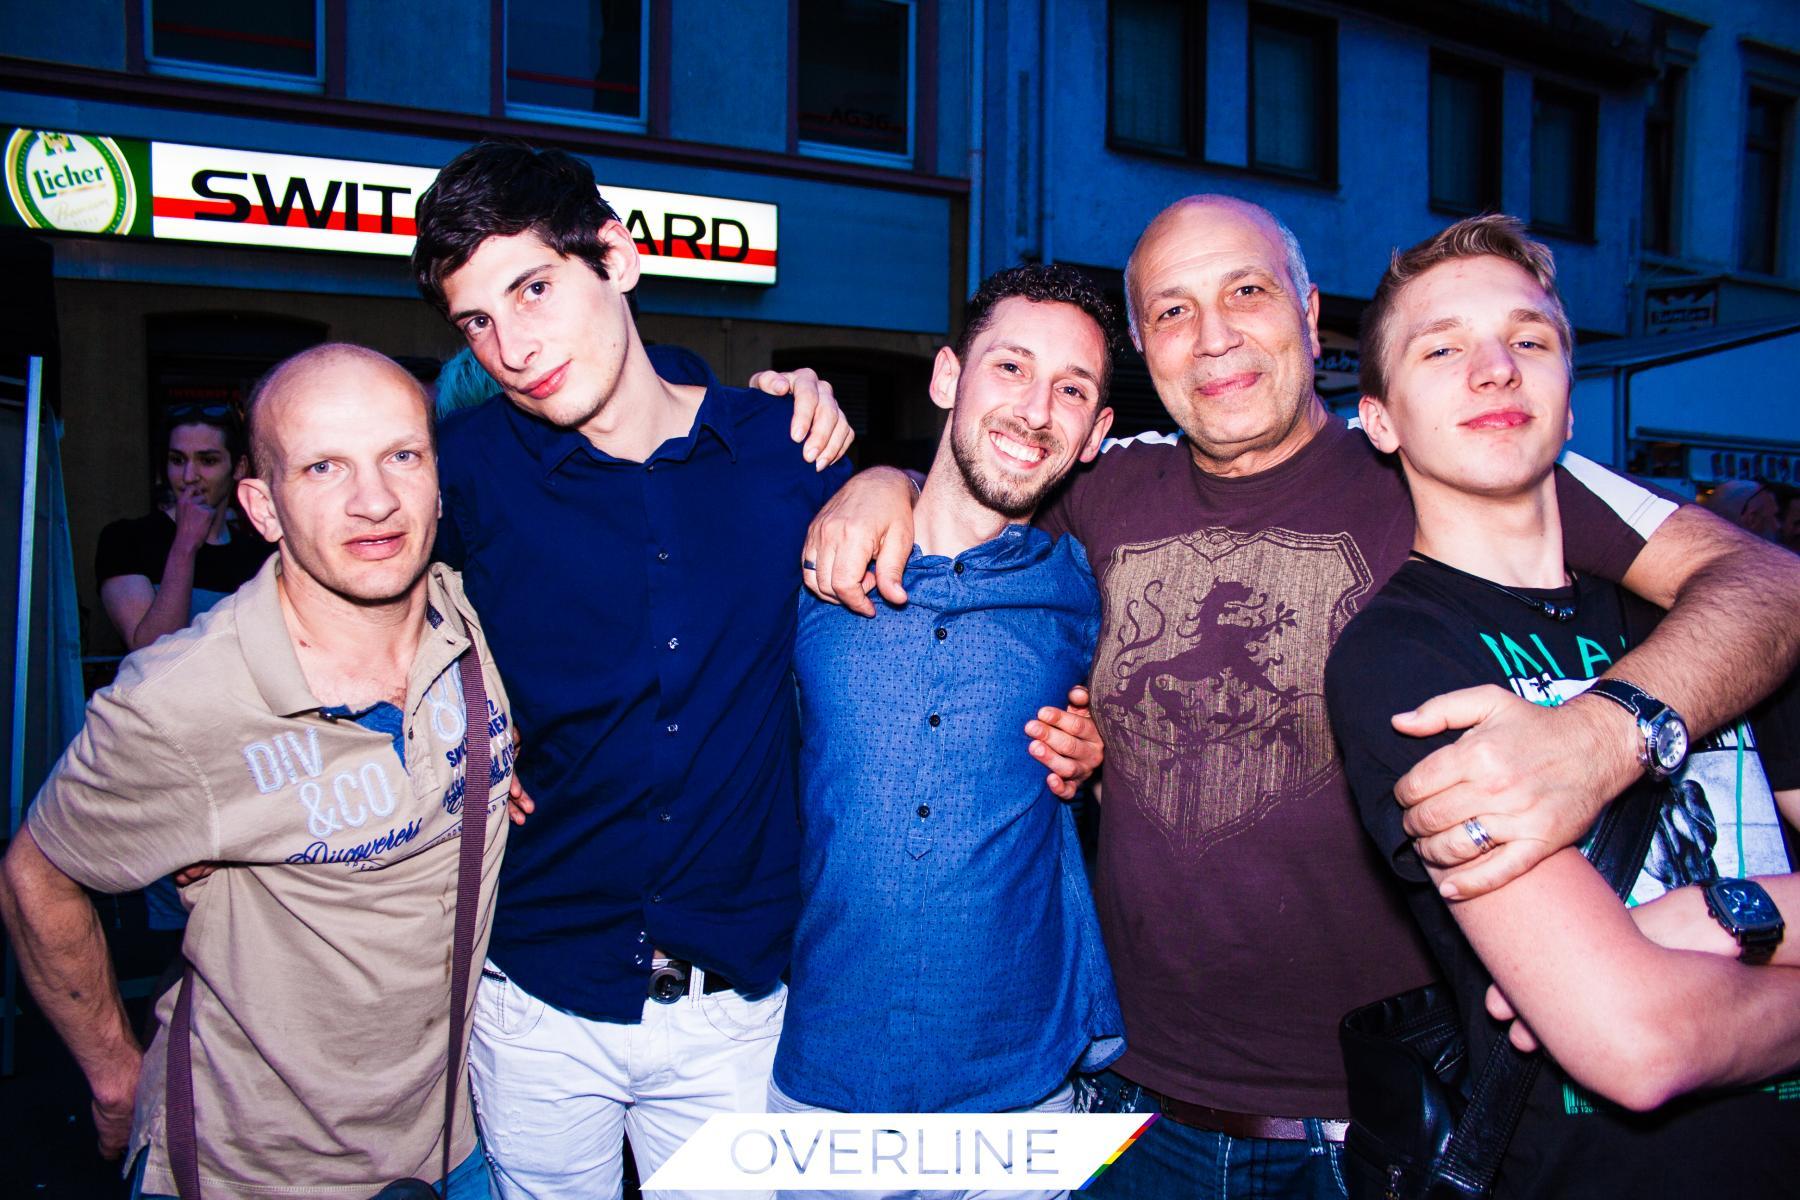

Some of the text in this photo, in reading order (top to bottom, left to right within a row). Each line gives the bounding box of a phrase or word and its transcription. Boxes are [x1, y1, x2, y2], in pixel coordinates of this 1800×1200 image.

[33, 164, 105, 200] Licher
[191, 169, 750, 264] SWITARD
[244, 726, 324, 795] DIV
[300, 761, 395, 838] &CO
